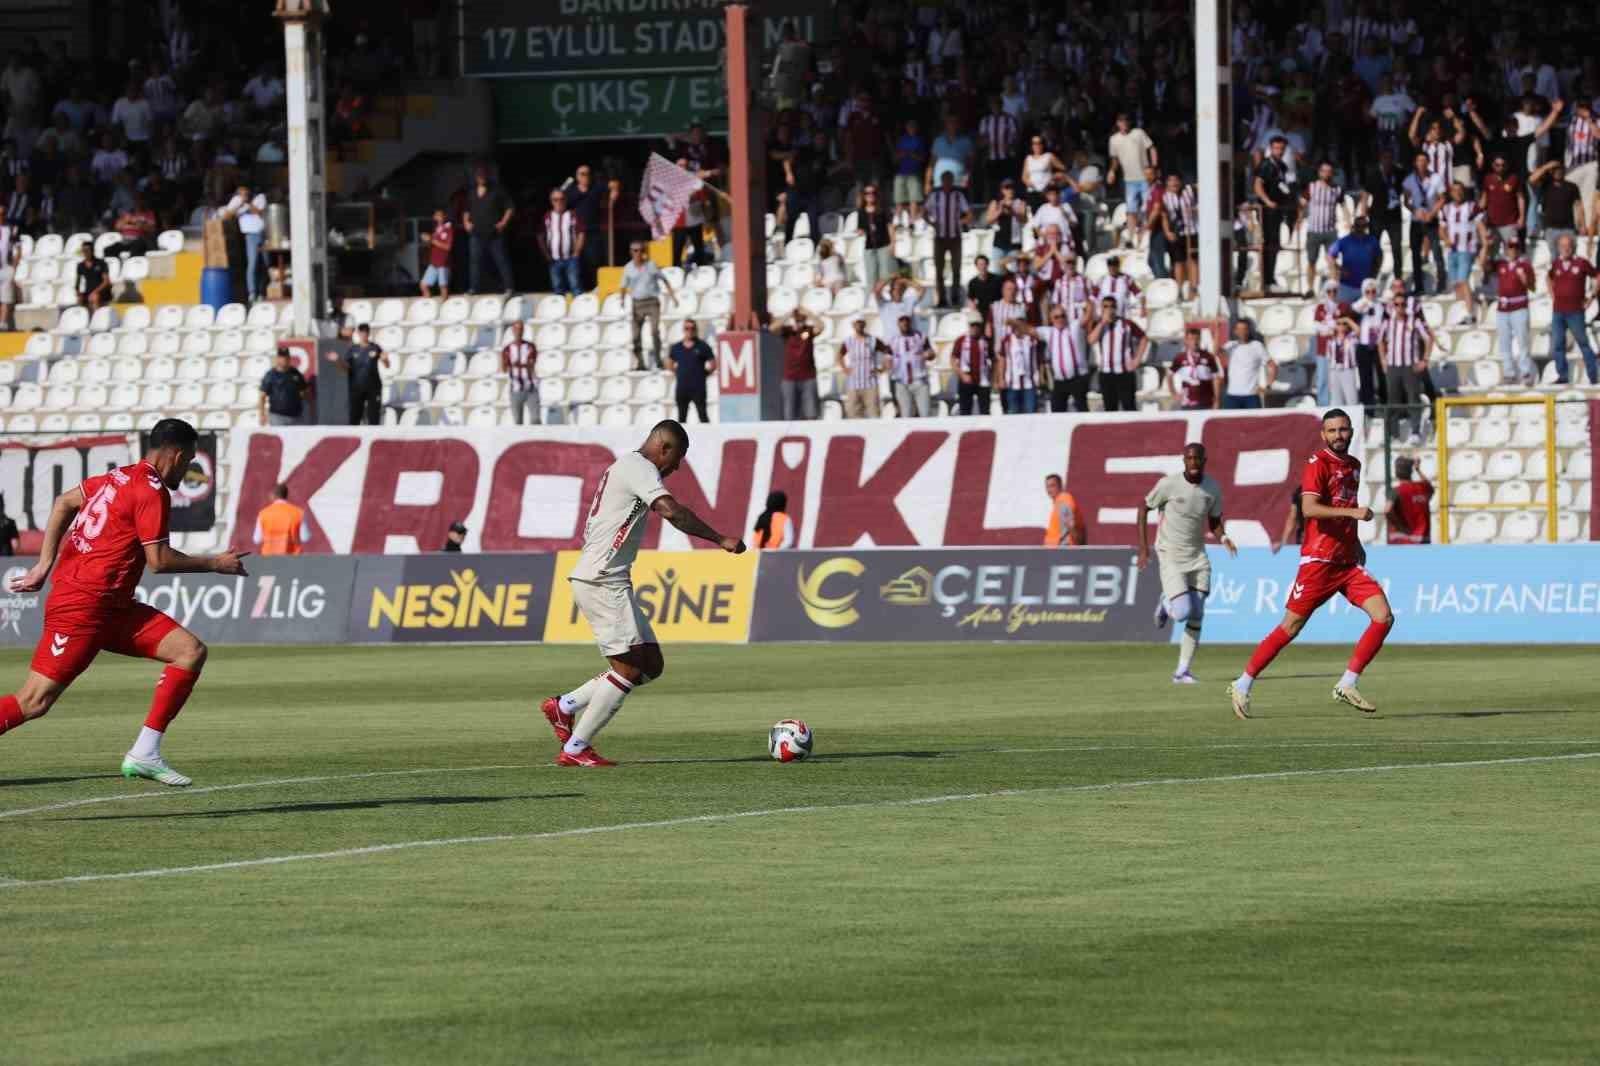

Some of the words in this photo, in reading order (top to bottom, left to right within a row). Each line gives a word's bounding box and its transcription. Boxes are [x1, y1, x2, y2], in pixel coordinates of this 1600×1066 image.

[483, 27, 516, 60] 17
[526, 17, 624, 58] EYLÜL
[551, 79, 650, 118] ÇIKIŞ
[720, 339, 755, 388] M
[933, 555, 1140, 617] ÇELEBİ
[1415, 583, 1600, 613] HASTANELE
